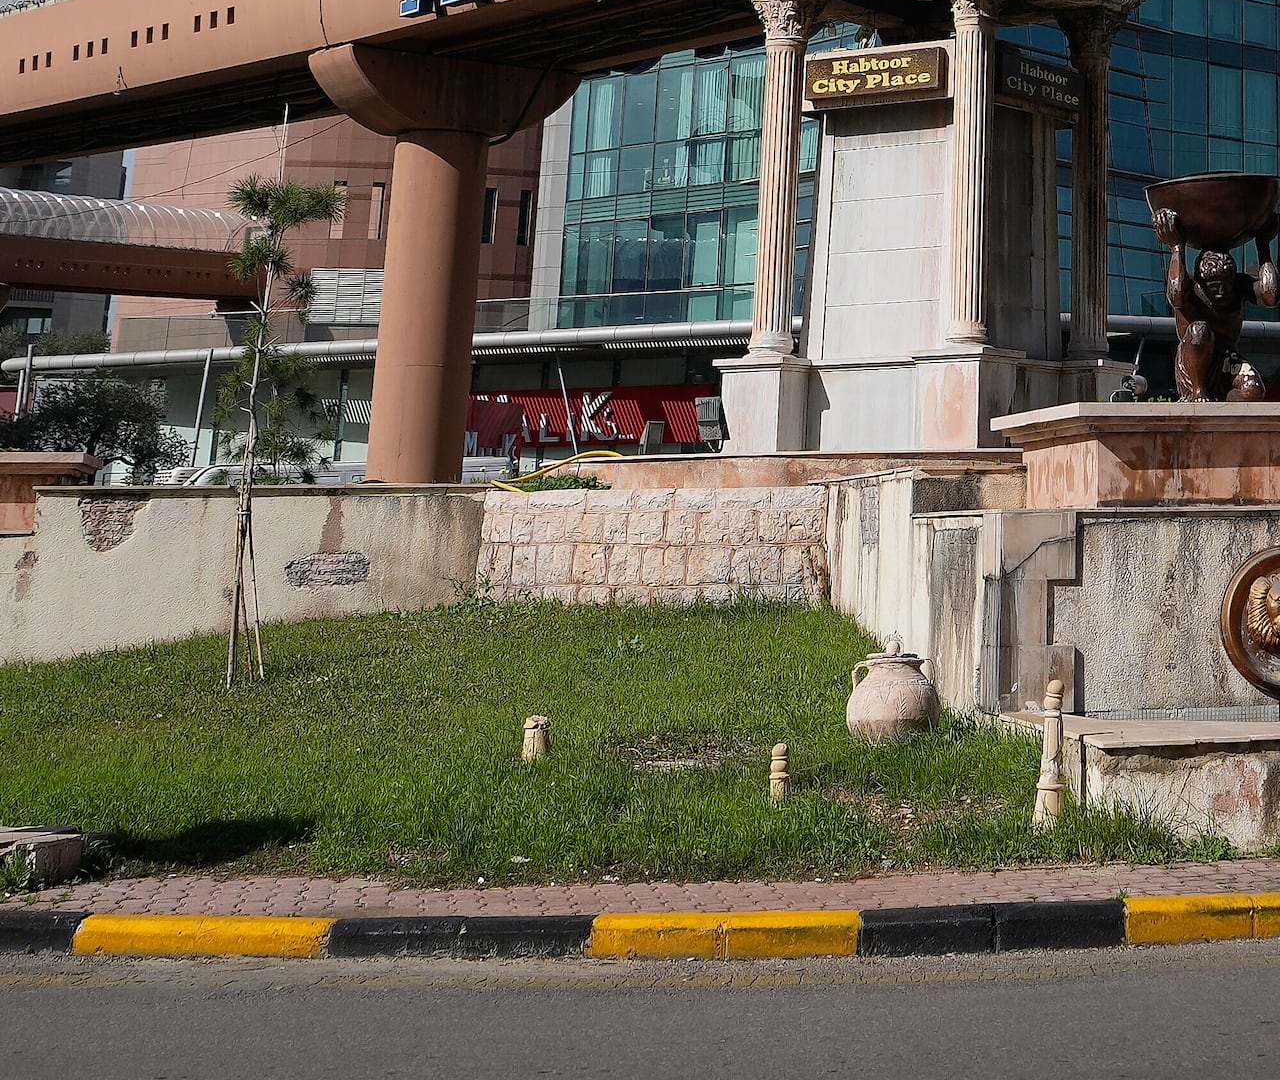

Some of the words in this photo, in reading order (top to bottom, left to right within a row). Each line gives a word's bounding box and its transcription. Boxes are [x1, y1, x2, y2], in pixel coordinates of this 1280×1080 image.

[832, 55, 913, 75] Habtoor
[1019, 61, 1068, 86] Habtoor
[812, 79, 861, 94] City
[865, 70, 931, 90] Place
[1006, 75, 1037, 97] City
[1041, 84, 1079, 106] Place
